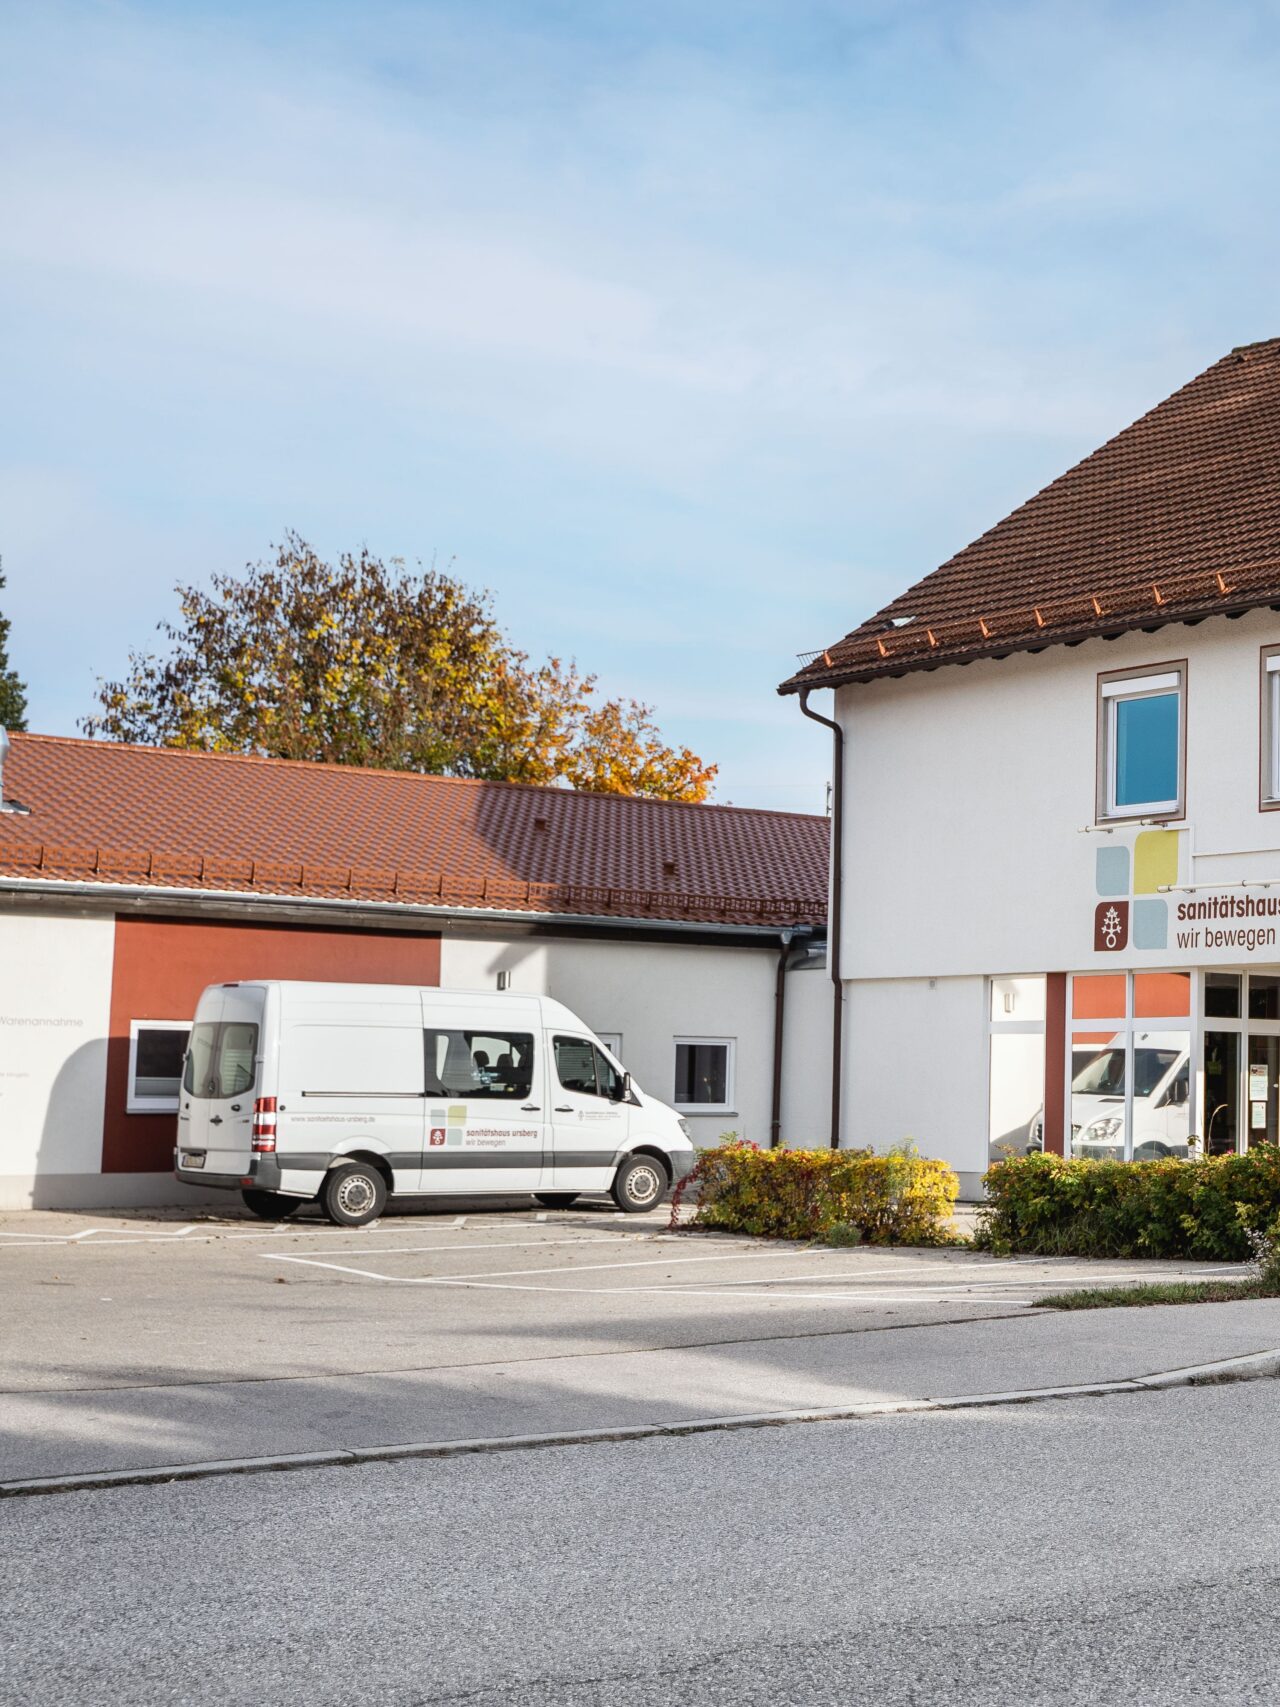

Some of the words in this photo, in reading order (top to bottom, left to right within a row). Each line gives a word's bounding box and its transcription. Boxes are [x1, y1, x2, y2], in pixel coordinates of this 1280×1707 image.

[1177, 928, 1200, 949] wir
[1205, 927, 1276, 951] bewegen
[466, 1128, 510, 1136] sanitätshaus
[512, 1129, 538, 1138] ursberg
[466, 1138, 476, 1146] wir
[477, 1138, 506, 1147] bewegen
